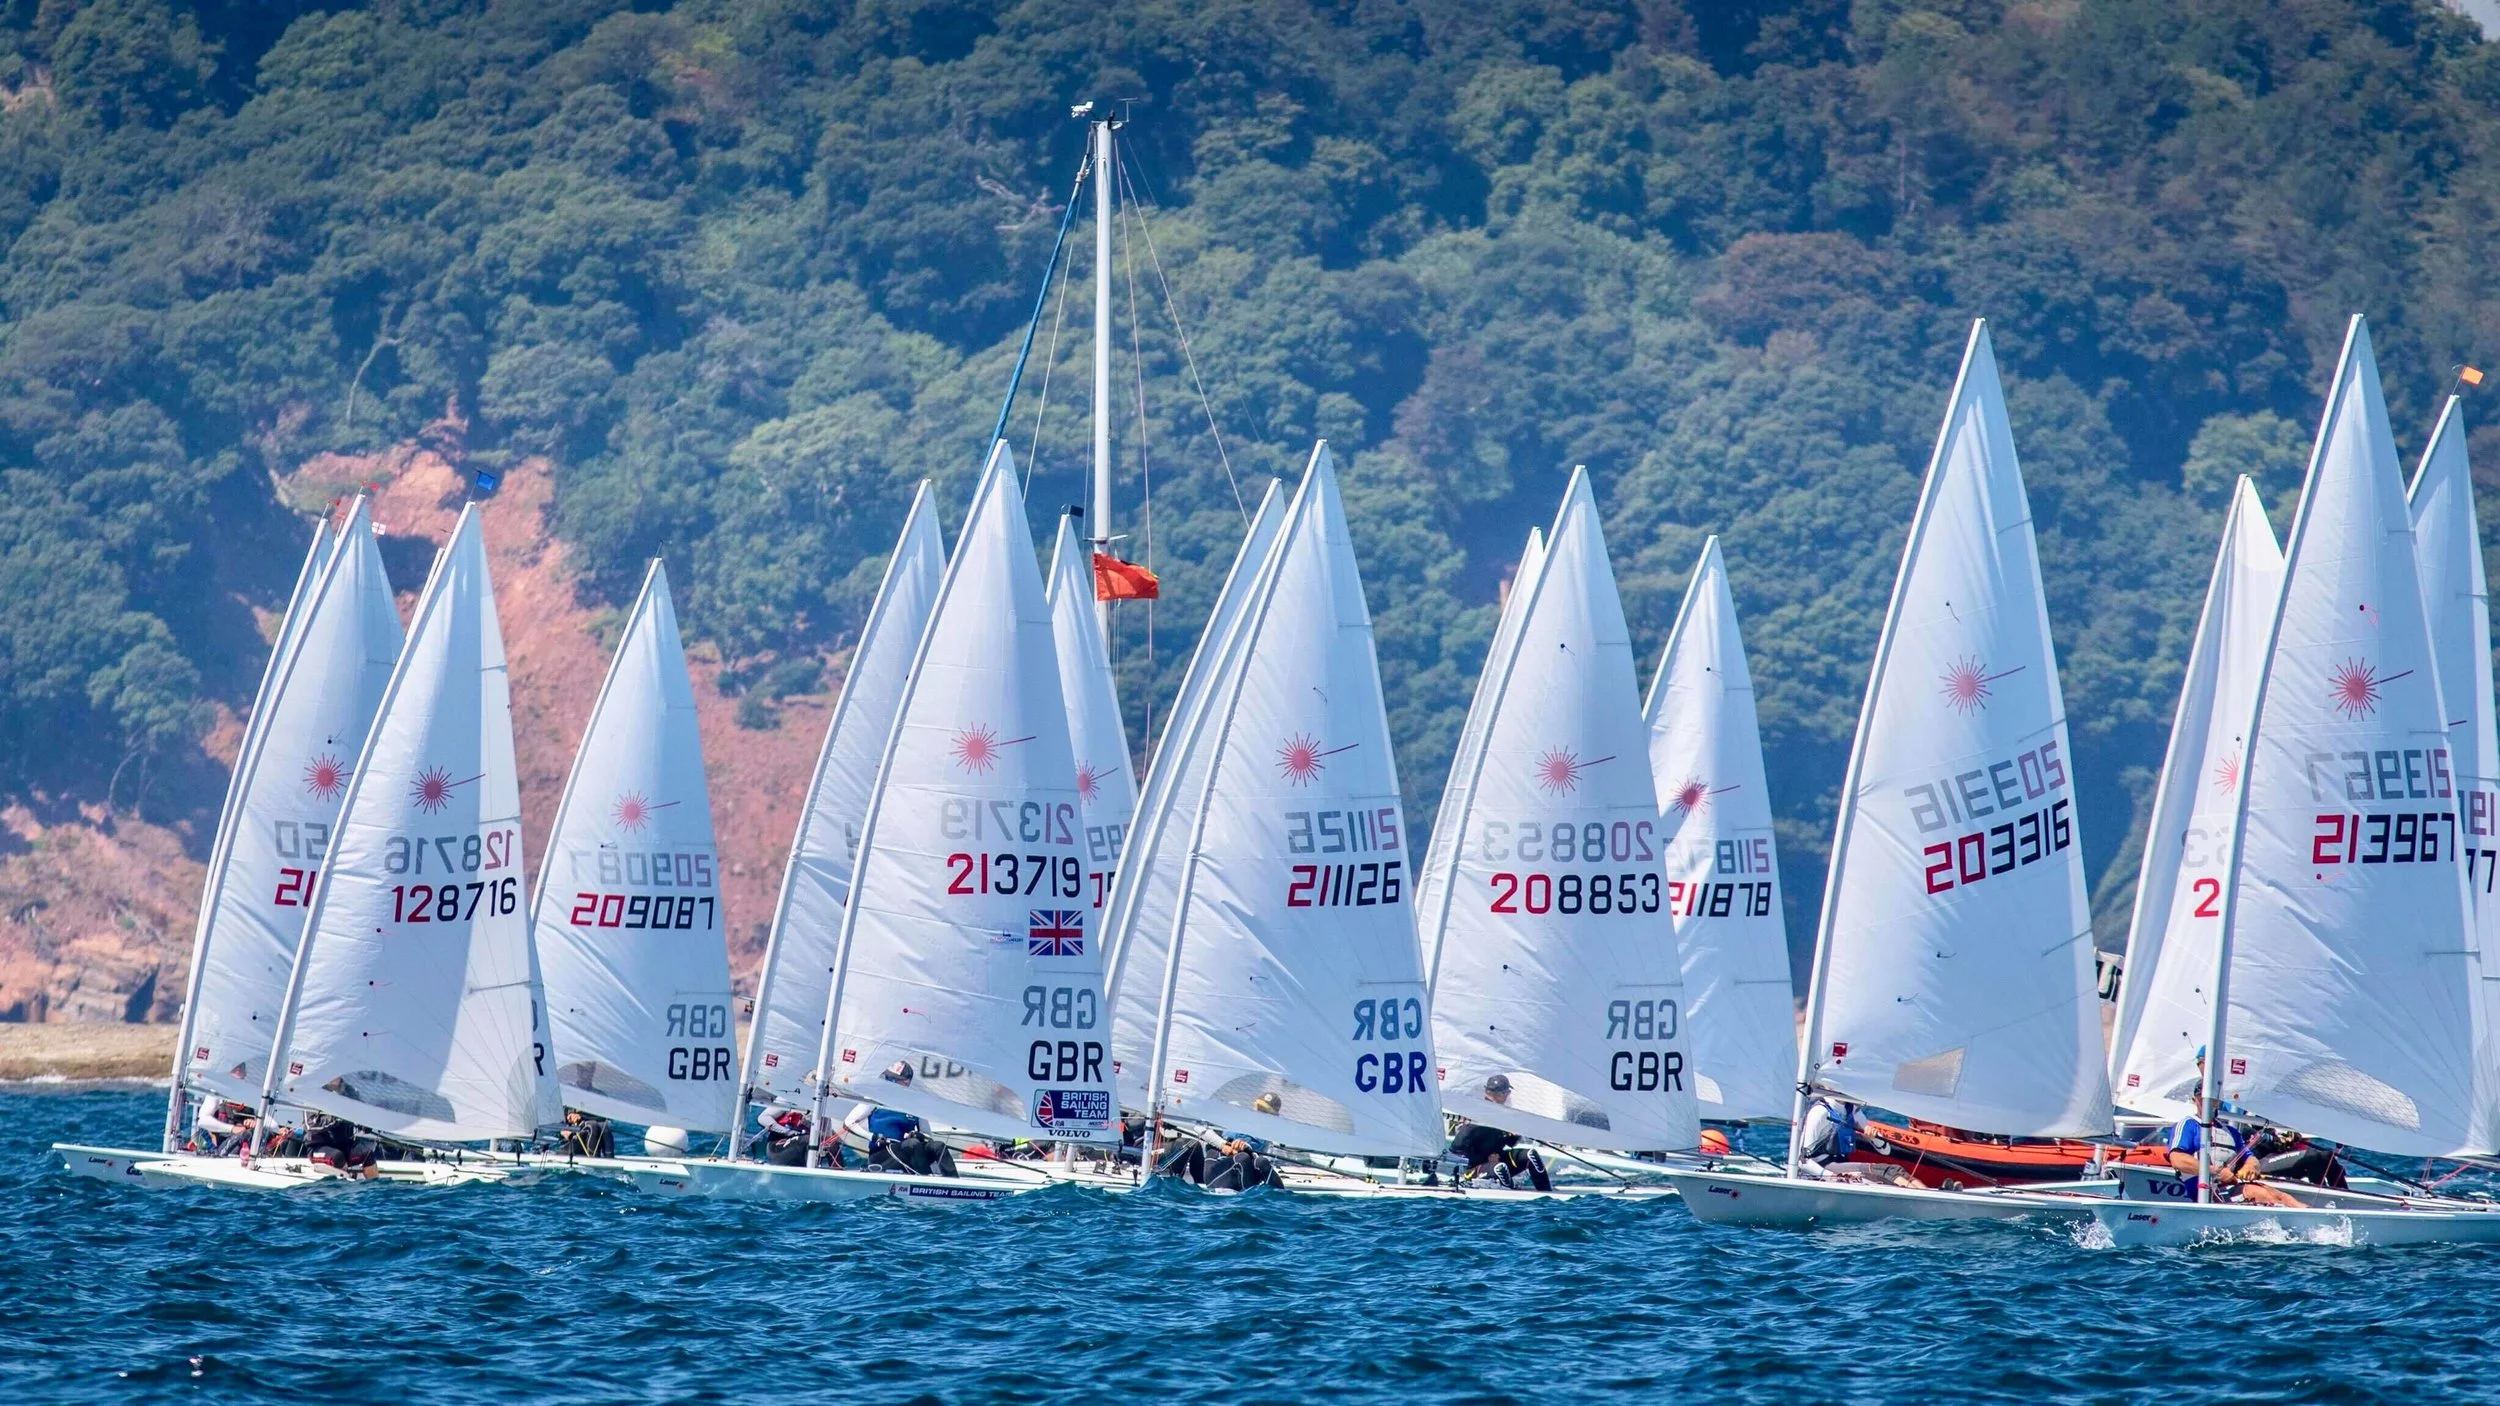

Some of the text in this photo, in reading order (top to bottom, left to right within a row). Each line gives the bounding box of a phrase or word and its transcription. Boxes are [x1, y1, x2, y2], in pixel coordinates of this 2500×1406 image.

[1923, 797, 2071, 896] 203316
[2311, 811, 2456, 865] 213967
[946, 852, 1082, 899] 213719
[1287, 860, 1402, 907] 211126
[1489, 872, 1661, 915] 208853
[391, 876, 518, 923] 128716
[570, 892, 715, 931] 209087
[1668, 881, 1772, 918] 211878
[668, 1047, 731, 1081] GBR
[1028, 1039, 1104, 1083] GBR
[1354, 1051, 1428, 1094] GBR
[1610, 1051, 1684, 1092] GBR
[1061, 1091, 1108, 1102] BRITISH
[1061, 1100, 1108, 1110] SAILING
[1074, 1109, 1108, 1119] TEAM
[1048, 1129, 1091, 1138] VOLVO
[911, 1186, 949, 1196] BRITISH
[950, 1189, 986, 1198] SAILING
[2127, 1212, 2152, 1221] Laser
